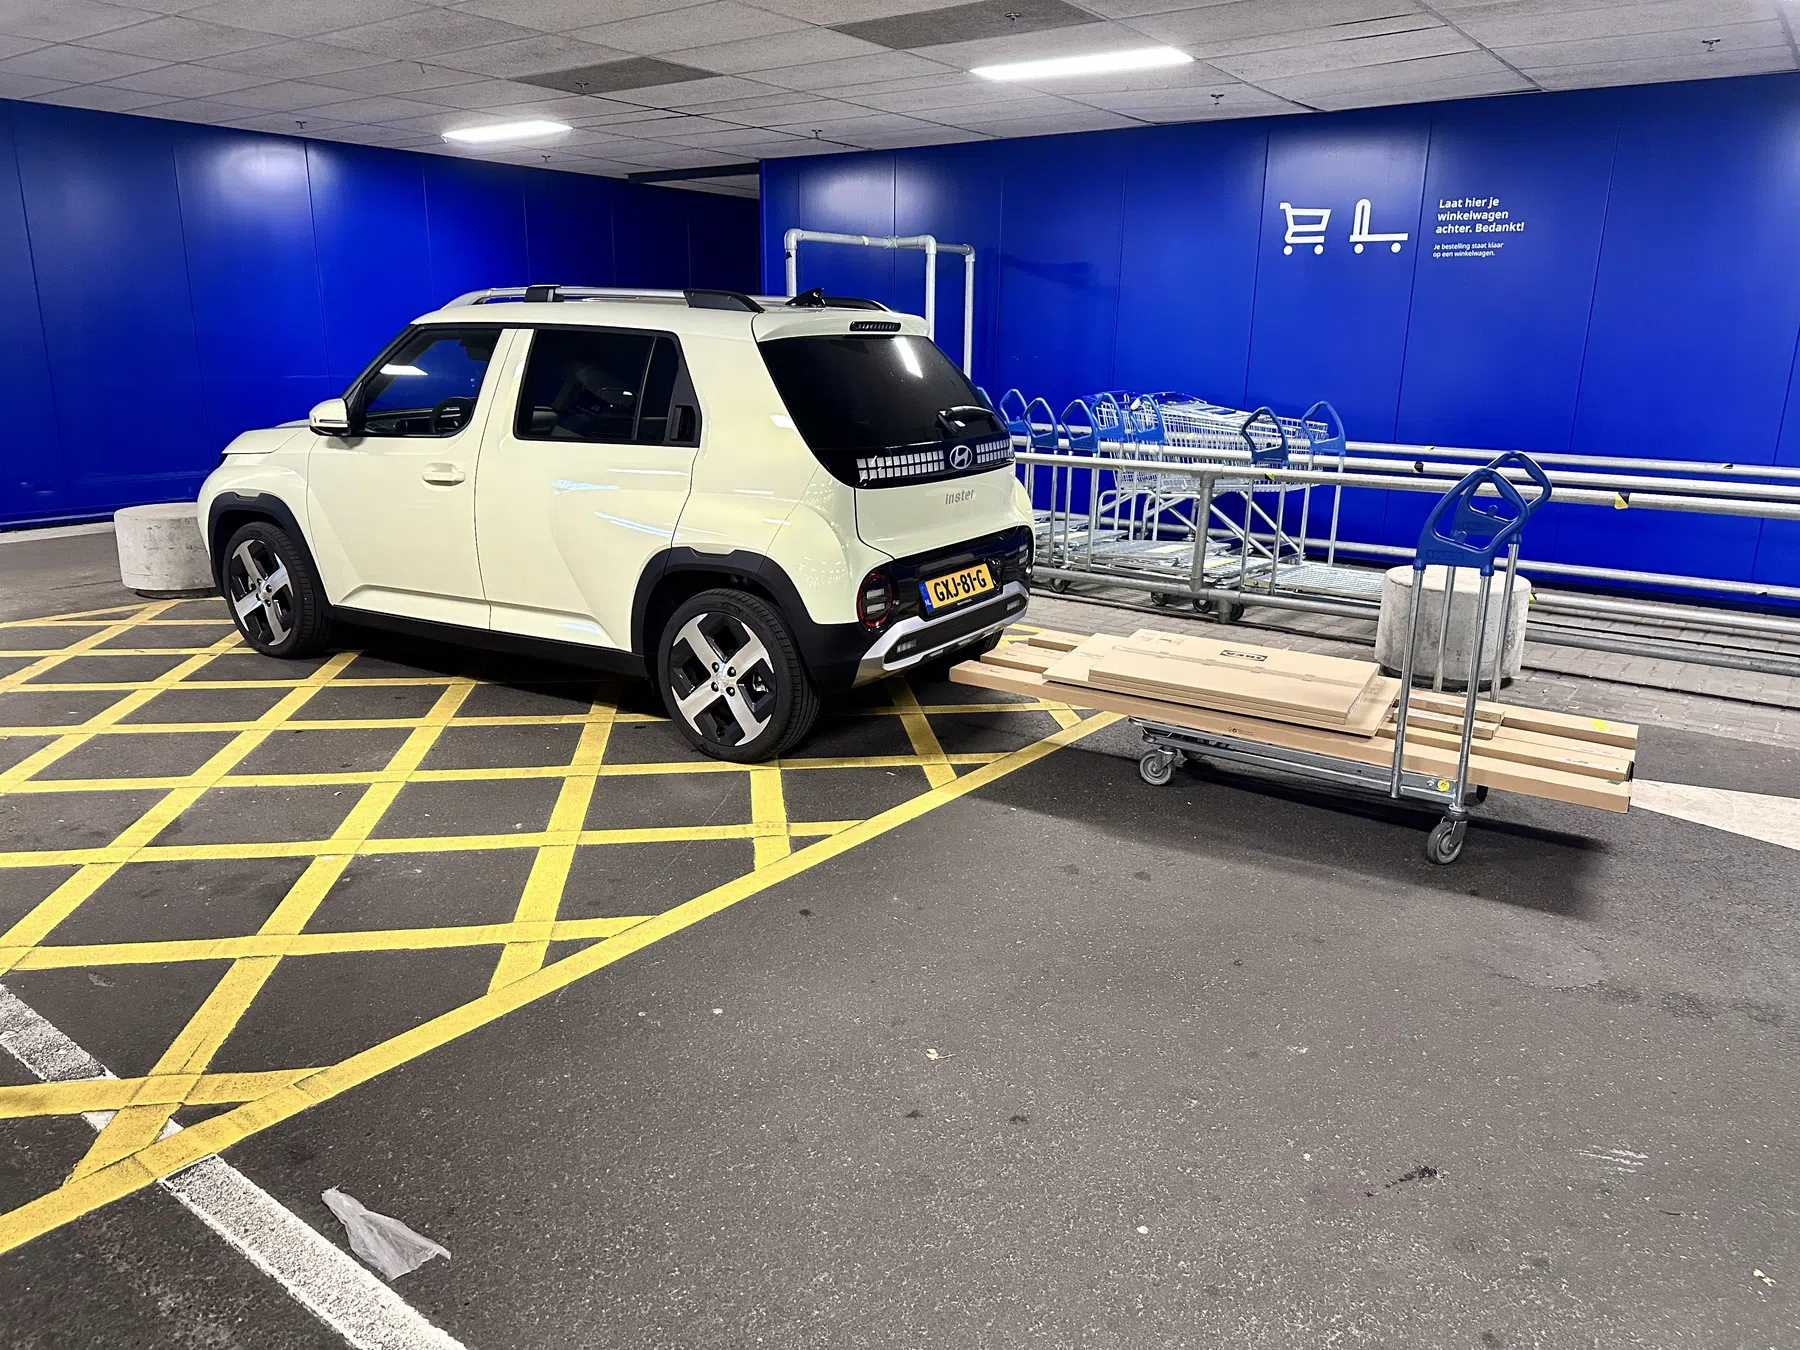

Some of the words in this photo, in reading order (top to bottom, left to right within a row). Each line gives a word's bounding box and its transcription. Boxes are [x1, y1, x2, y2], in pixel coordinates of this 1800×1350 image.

[1439, 199, 1463, 209] Laat
[1465, 197, 1487, 208] hier
[1487, 197, 1499, 209] je
[1437, 210, 1509, 222] winkelwagen
[1435, 223, 1473, 234] achter.
[1475, 221, 1525, 233] Bedankt!
[1454, 250, 1496, 258] winkelwagen.
[933, 569, 987, 602] GXJ-81-G
